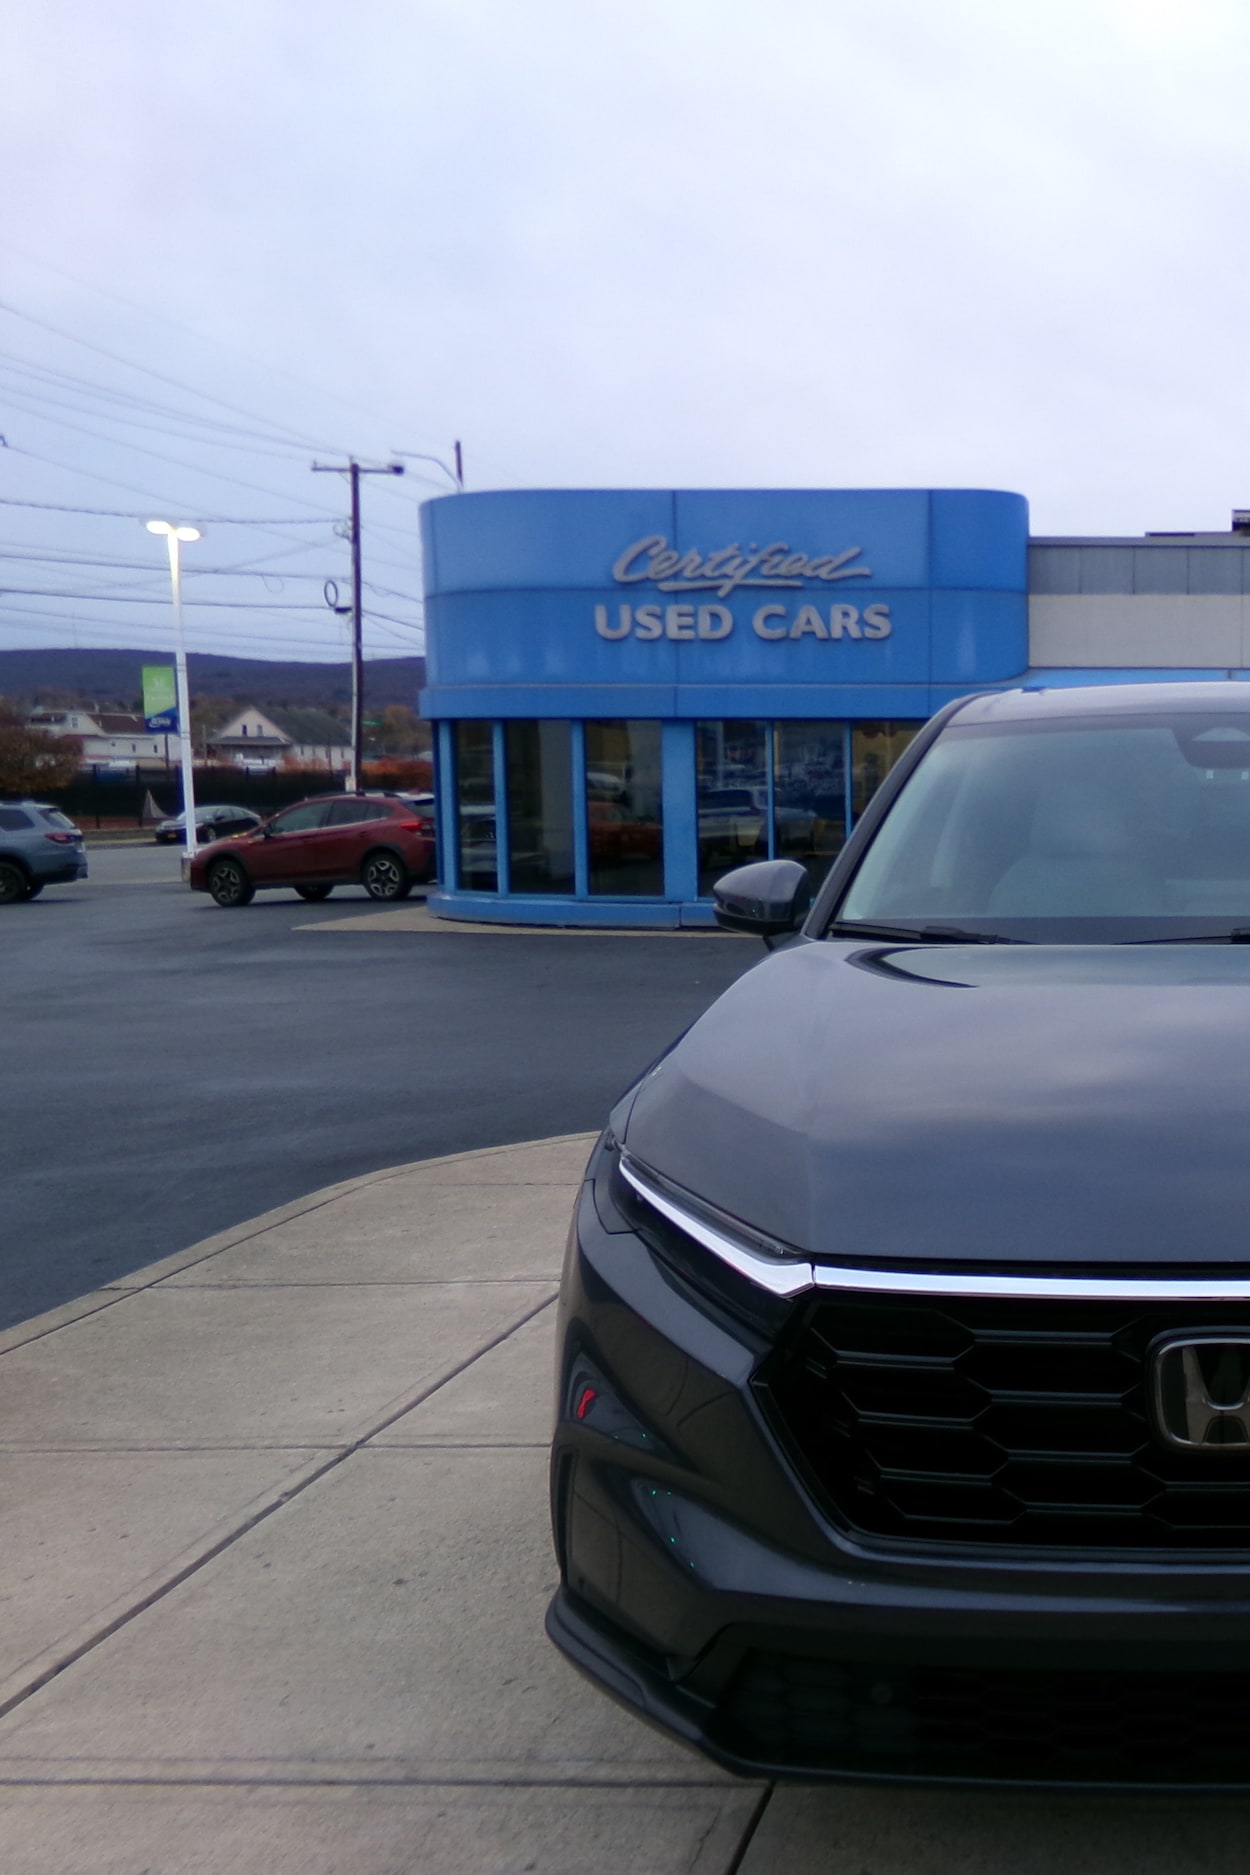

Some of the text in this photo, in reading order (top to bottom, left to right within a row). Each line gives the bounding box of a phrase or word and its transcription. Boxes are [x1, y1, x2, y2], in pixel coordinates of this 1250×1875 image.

[612, 535, 873, 599] Certified
[594, 603, 893, 640] USED CARS
